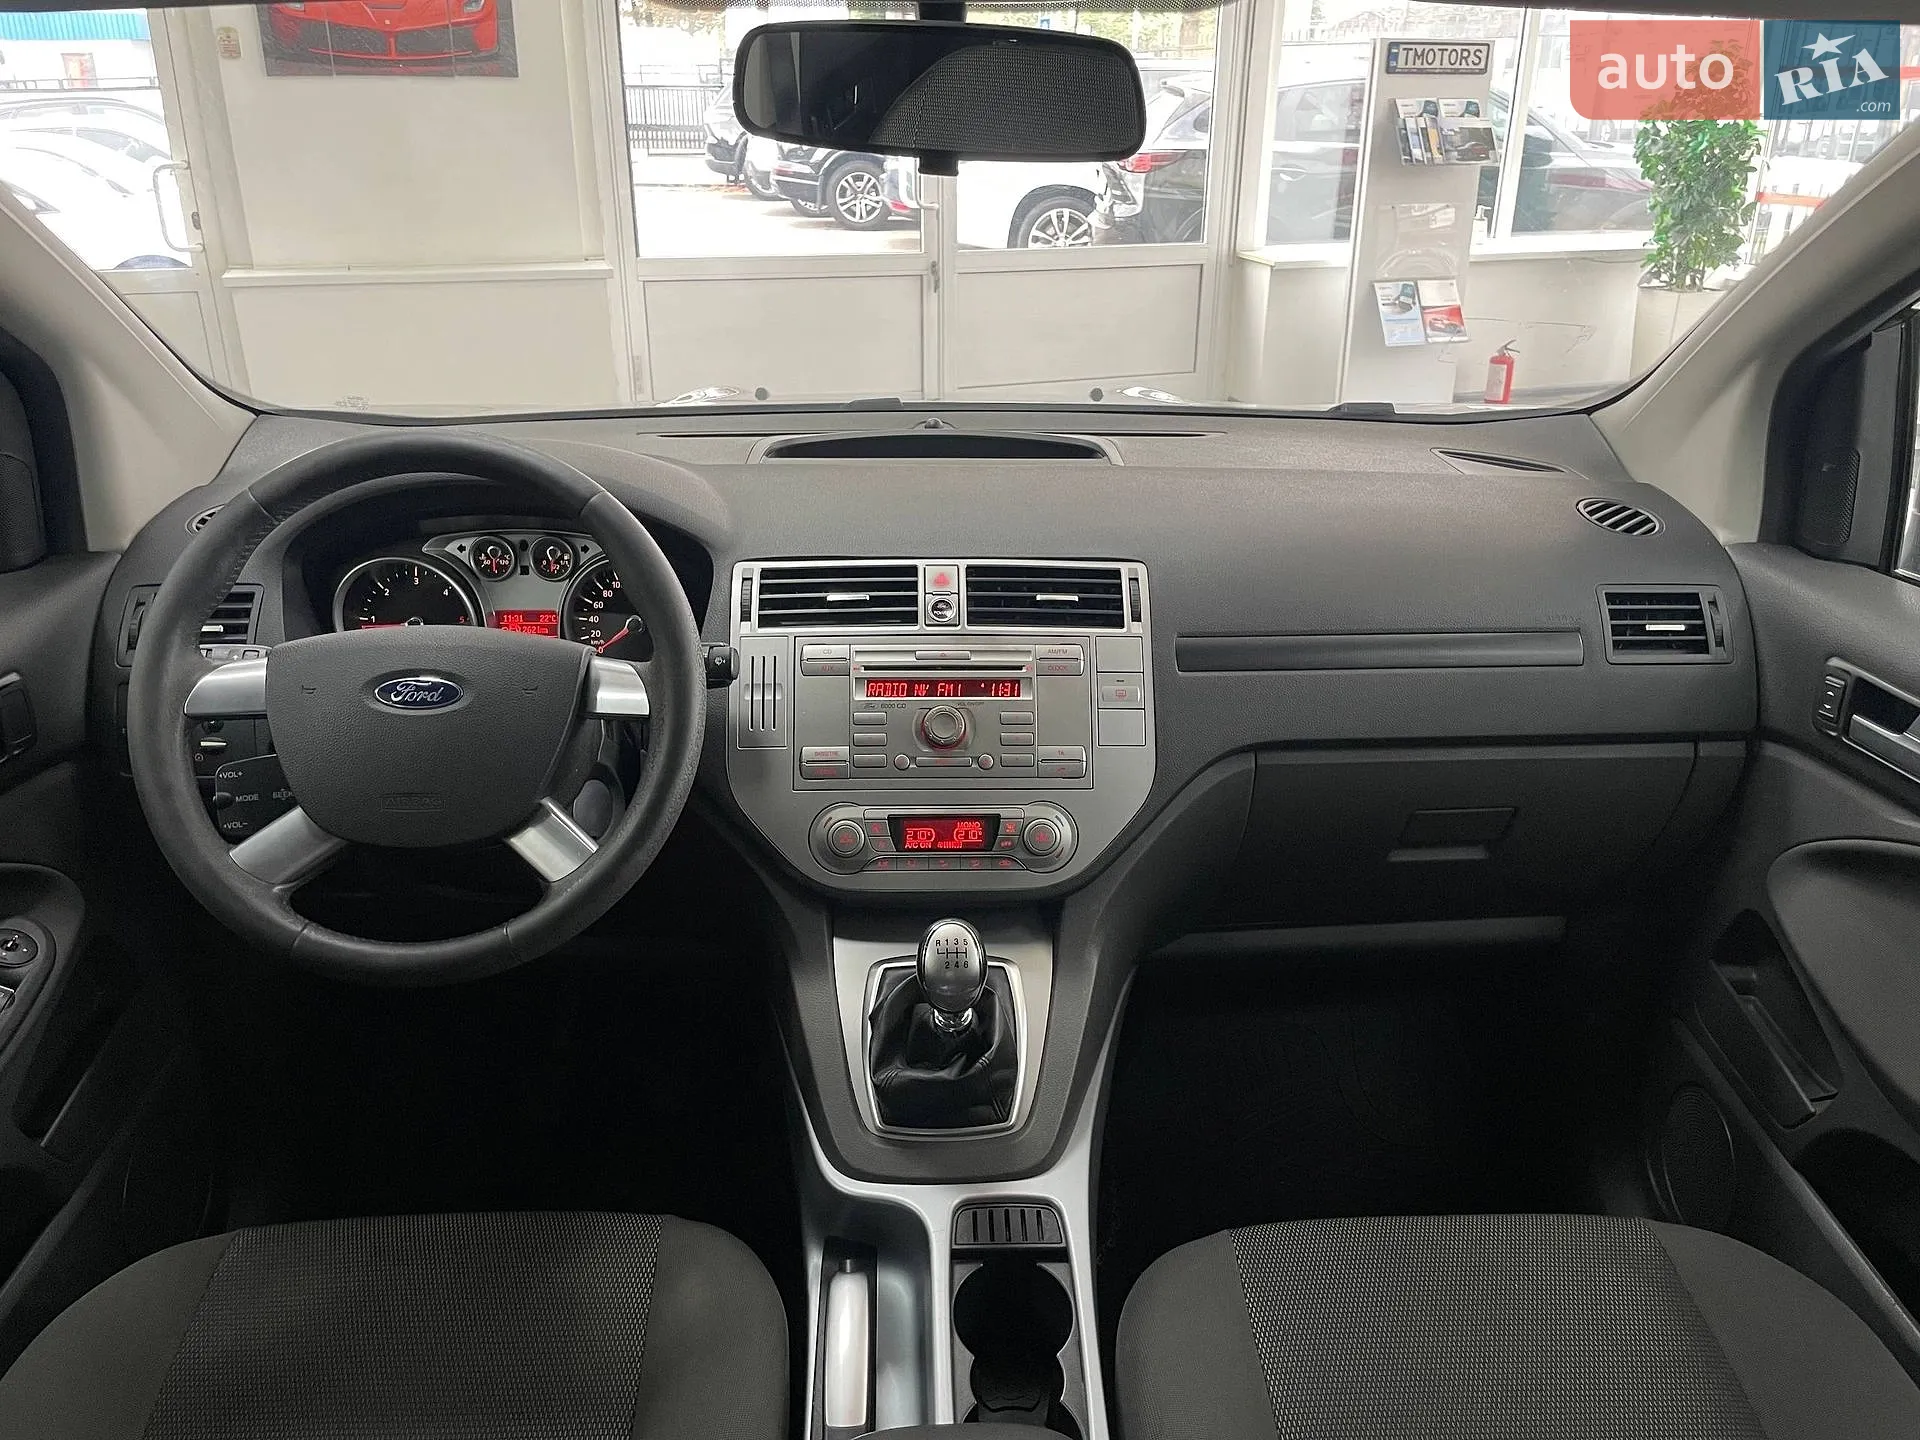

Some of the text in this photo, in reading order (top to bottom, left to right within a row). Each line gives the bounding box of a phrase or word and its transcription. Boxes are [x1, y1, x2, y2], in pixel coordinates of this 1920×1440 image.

[1402, 47, 1482, 66] TMOTORS
[413, 577, 420, 585] 3
[384, 588, 390, 596] 2
[443, 588, 449, 596] 4
[602, 590, 613, 598] 80
[593, 601, 604, 609] 60
[370, 615, 376, 623] 1
[503, 614, 556, 622] 11:31 22°C
[588, 615, 599, 623] 40
[590, 630, 601, 638] 20
[598, 646, 604, 654] 0
[390, 681, 444, 702] Ford
[867, 682, 908, 697] RADIO
[991, 682, 1019, 697] 11:31
[235, 793, 259, 802] MODE
[945, 938, 949, 946] 1
[953, 937, 959, 946] 3
[963, 938, 969, 946] 5
[944, 960, 969, 969] 2 4 6
